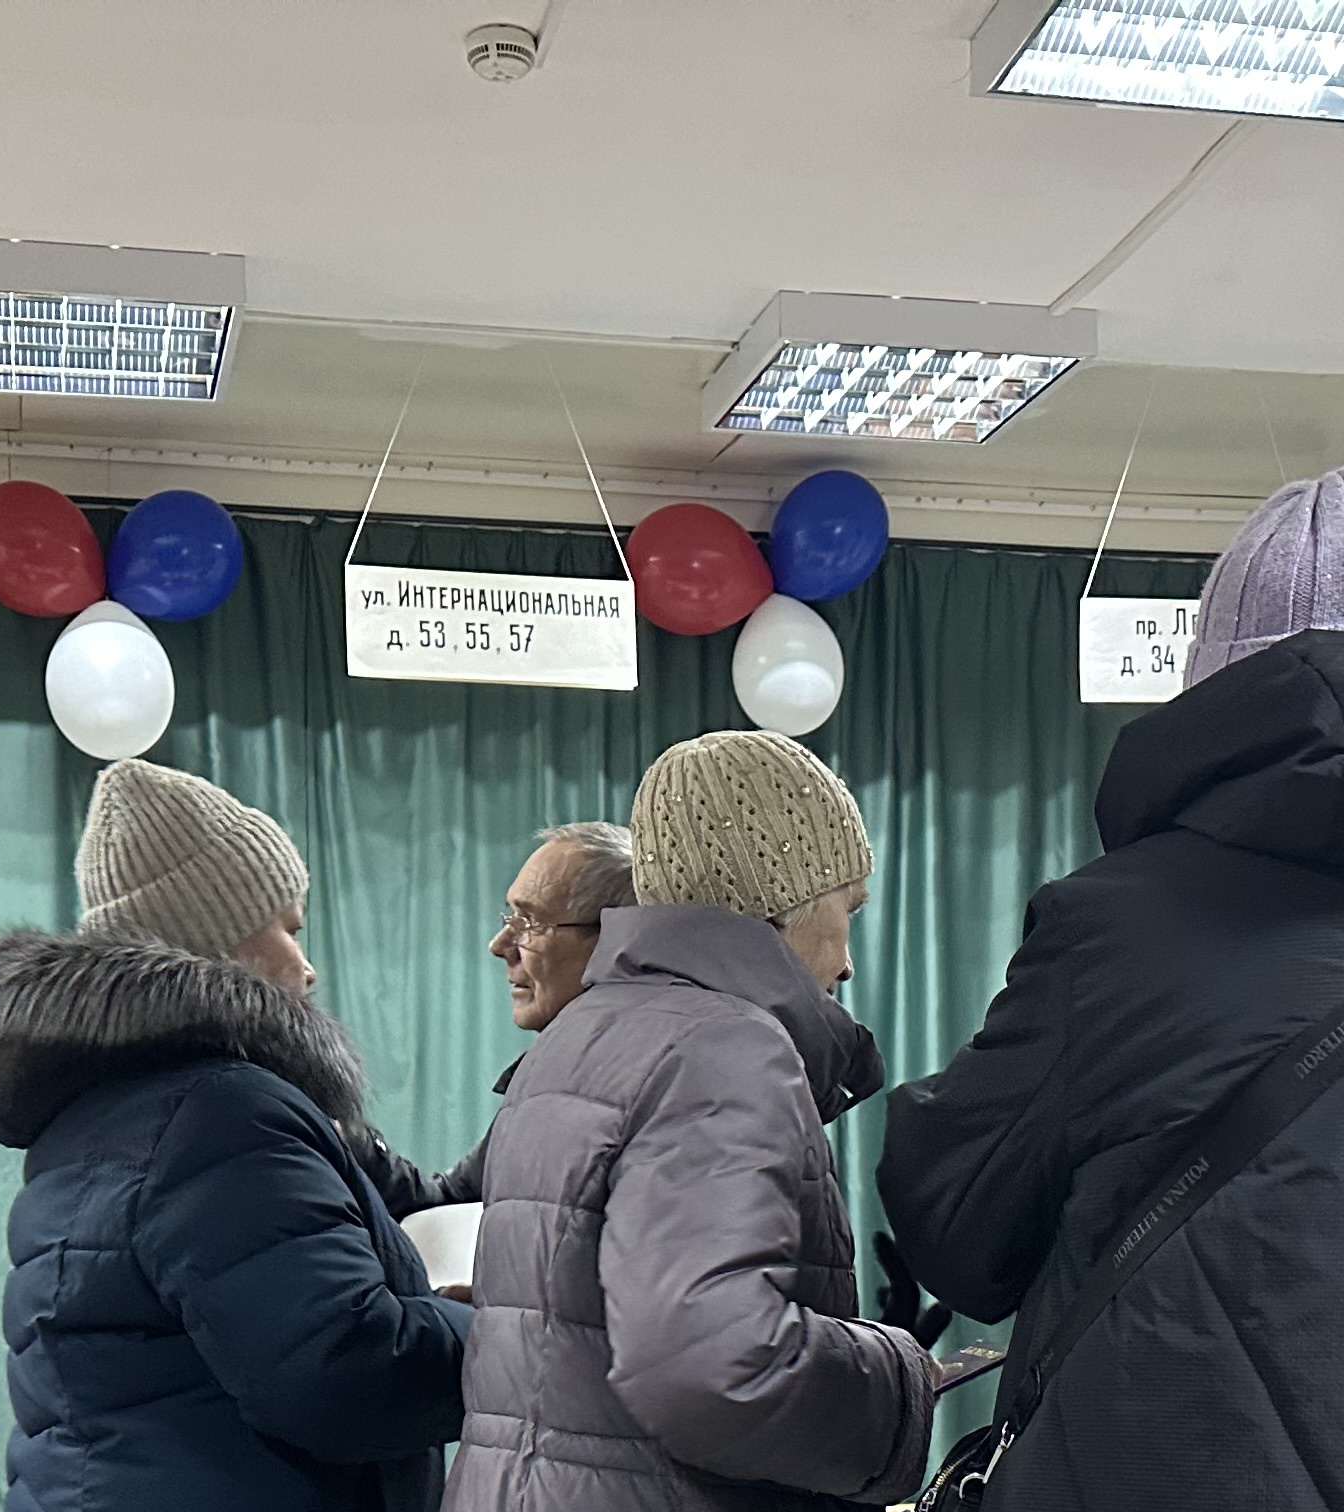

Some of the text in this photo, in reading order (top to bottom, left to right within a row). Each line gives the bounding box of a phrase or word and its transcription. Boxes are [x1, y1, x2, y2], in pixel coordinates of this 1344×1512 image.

[361, 588, 392, 610] ул.
[386, 629, 410, 651] д.
[509, 623, 536, 653] 57
[1135, 620, 1163, 640] пр.
[1120, 655, 1142, 677] д.
[1162, 1156, 1210, 1206] POLINA
